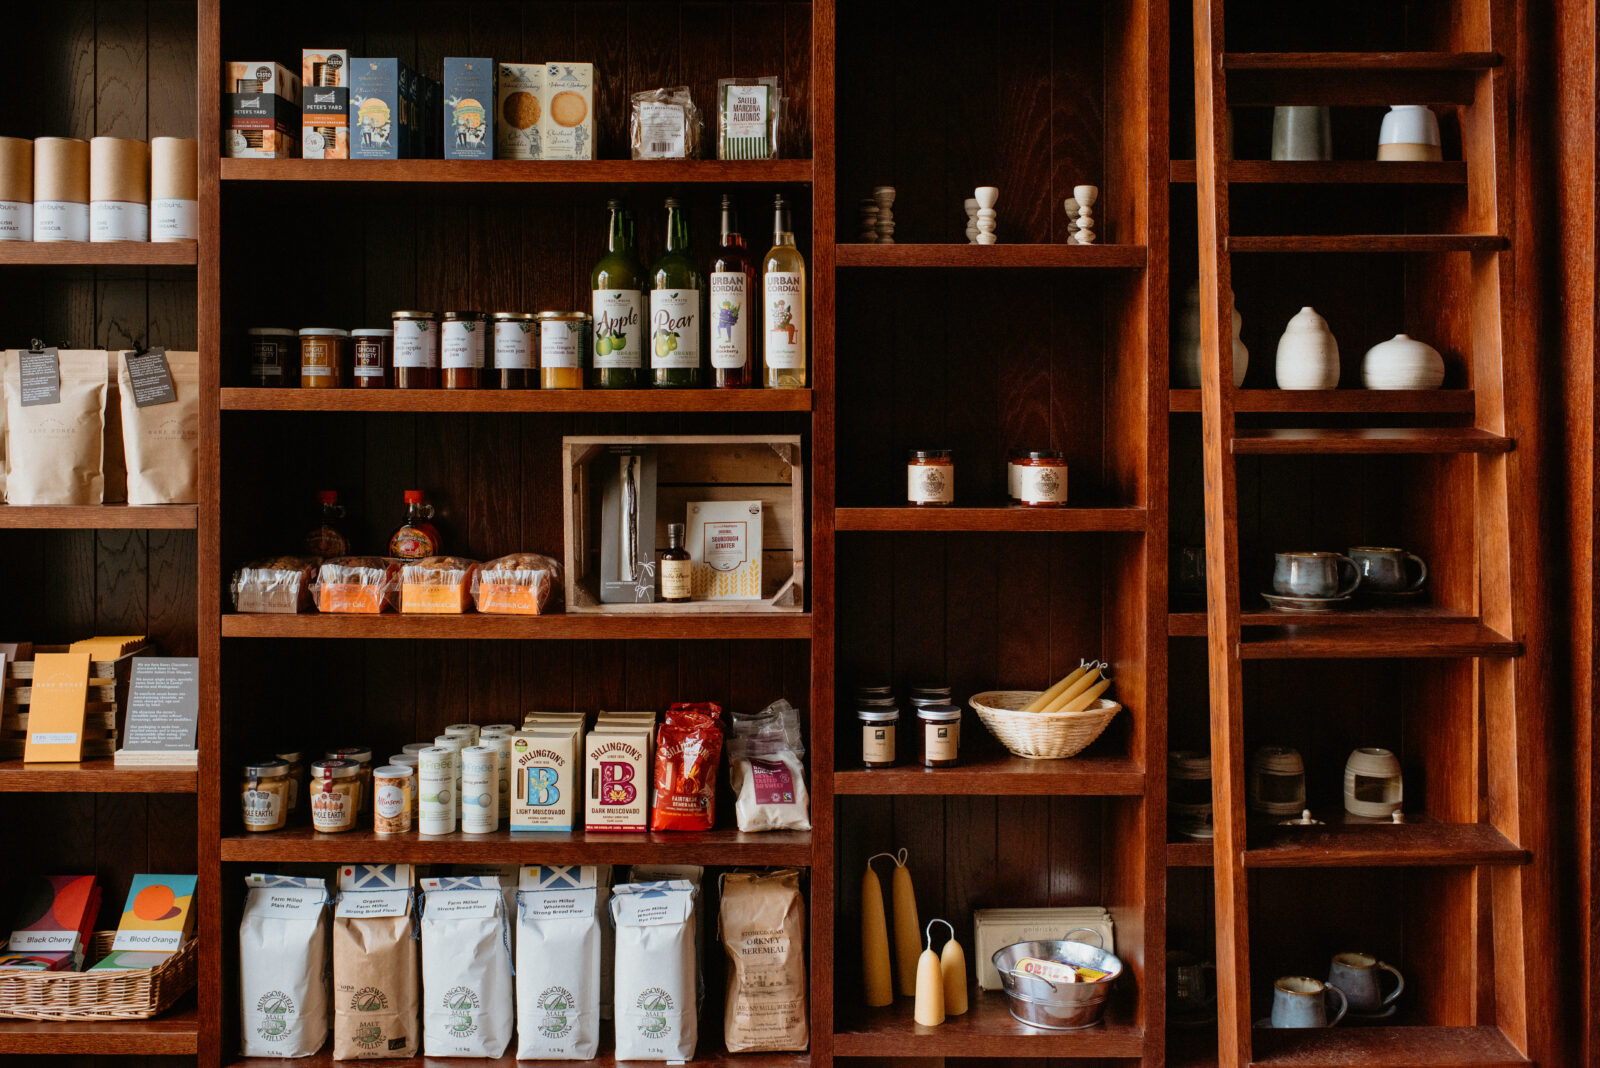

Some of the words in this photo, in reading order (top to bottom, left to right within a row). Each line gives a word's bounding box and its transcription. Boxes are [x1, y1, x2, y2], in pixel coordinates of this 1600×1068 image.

[733, 113, 760, 122] ALMONDS
[712, 276, 743, 285] URBAN
[768, 276, 799, 285] URBAN
[597, 307, 638, 335] Apple
[654, 309, 694, 332] Pear
[519, 750, 565, 766] BILLINGTON'S
[591, 742, 642, 761] BILLINGTON'S
[526, 767, 560, 806] B
[600, 762, 637, 805] B
[49, 936, 72, 945] Cherry
[746, 937, 780, 946] ORKNEY
[742, 946, 786, 955] BEREMEAL
[257, 990, 295, 1014] MUNGOSWELLS
[351, 986, 388, 1010] MUNGOSWELLS
[442, 986, 480, 1009] MUNGOSWELLS
[537, 986, 575, 1009] MUNGOSWELLS
[636, 987, 674, 1010] MUNGOSWELLS
[261, 1029, 292, 1042] MILLING
[449, 1025, 478, 1038] MILLING
[542, 1025, 572, 1039] MILLING
[642, 1026, 672, 1039] MILLING
[357, 1034, 388, 1049] MILLING
